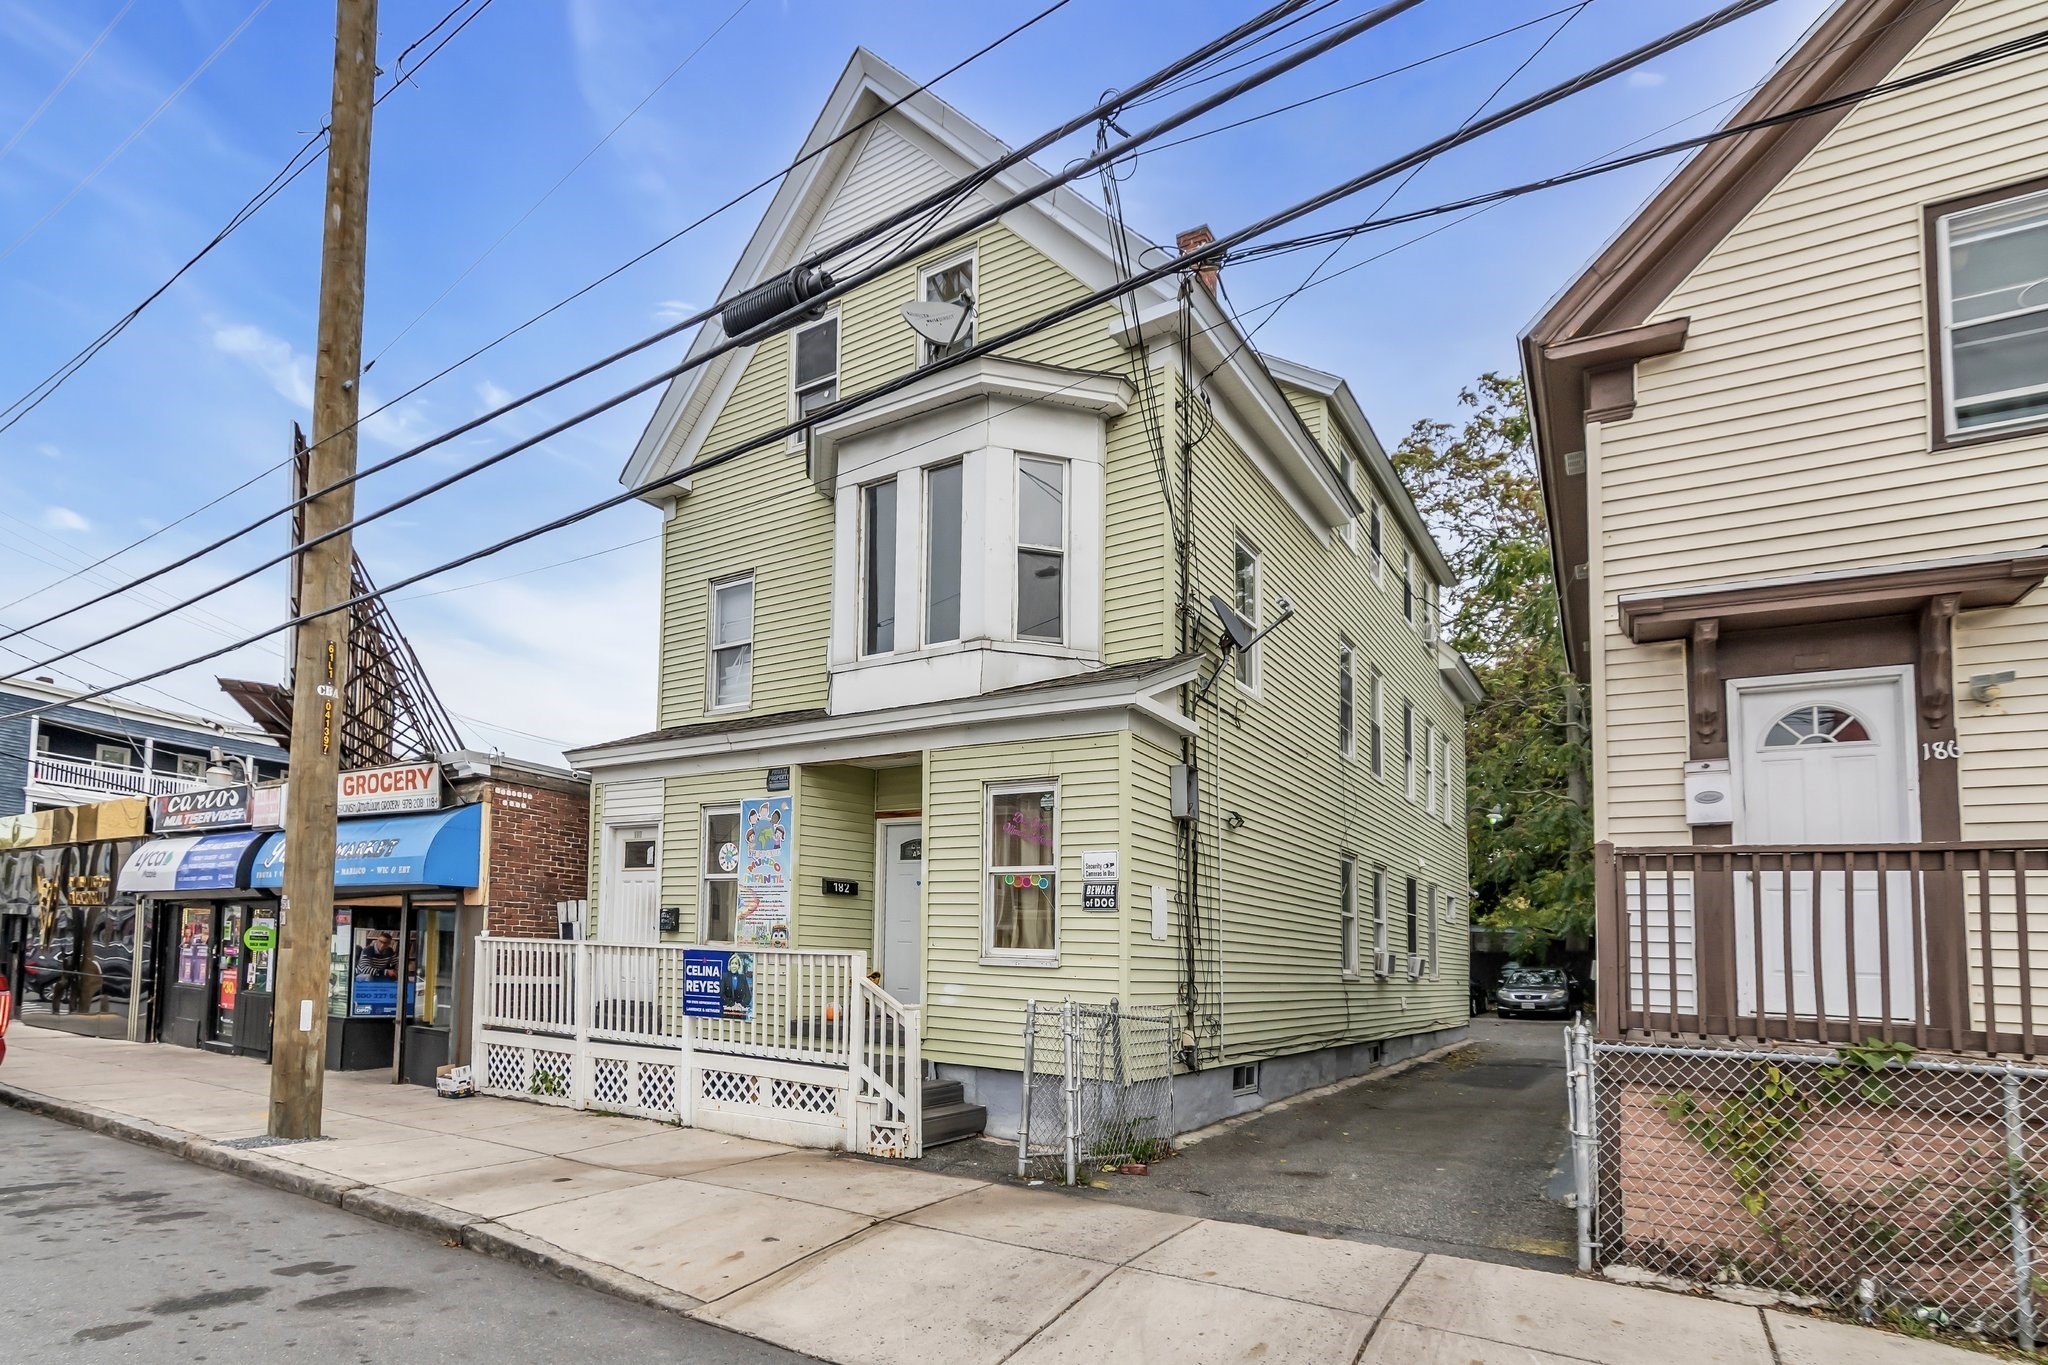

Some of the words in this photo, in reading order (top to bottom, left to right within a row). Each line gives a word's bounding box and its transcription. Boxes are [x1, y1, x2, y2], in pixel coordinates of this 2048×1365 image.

[323, 702, 332, 752] 041397
[1922, 740, 1961, 760] 186
[343, 767, 434, 796] GROCERY
[747, 857, 781, 873] MUNDO
[744, 873, 784, 884] INFANTIL
[833, 882, 850, 893] 182
[1086, 885, 1115, 895] BEWARE
[1086, 898, 1094, 907] of
[1094, 898, 1115, 908] DOG
[686, 965, 720, 977] CELINA
[686, 980, 720, 994] REYES
